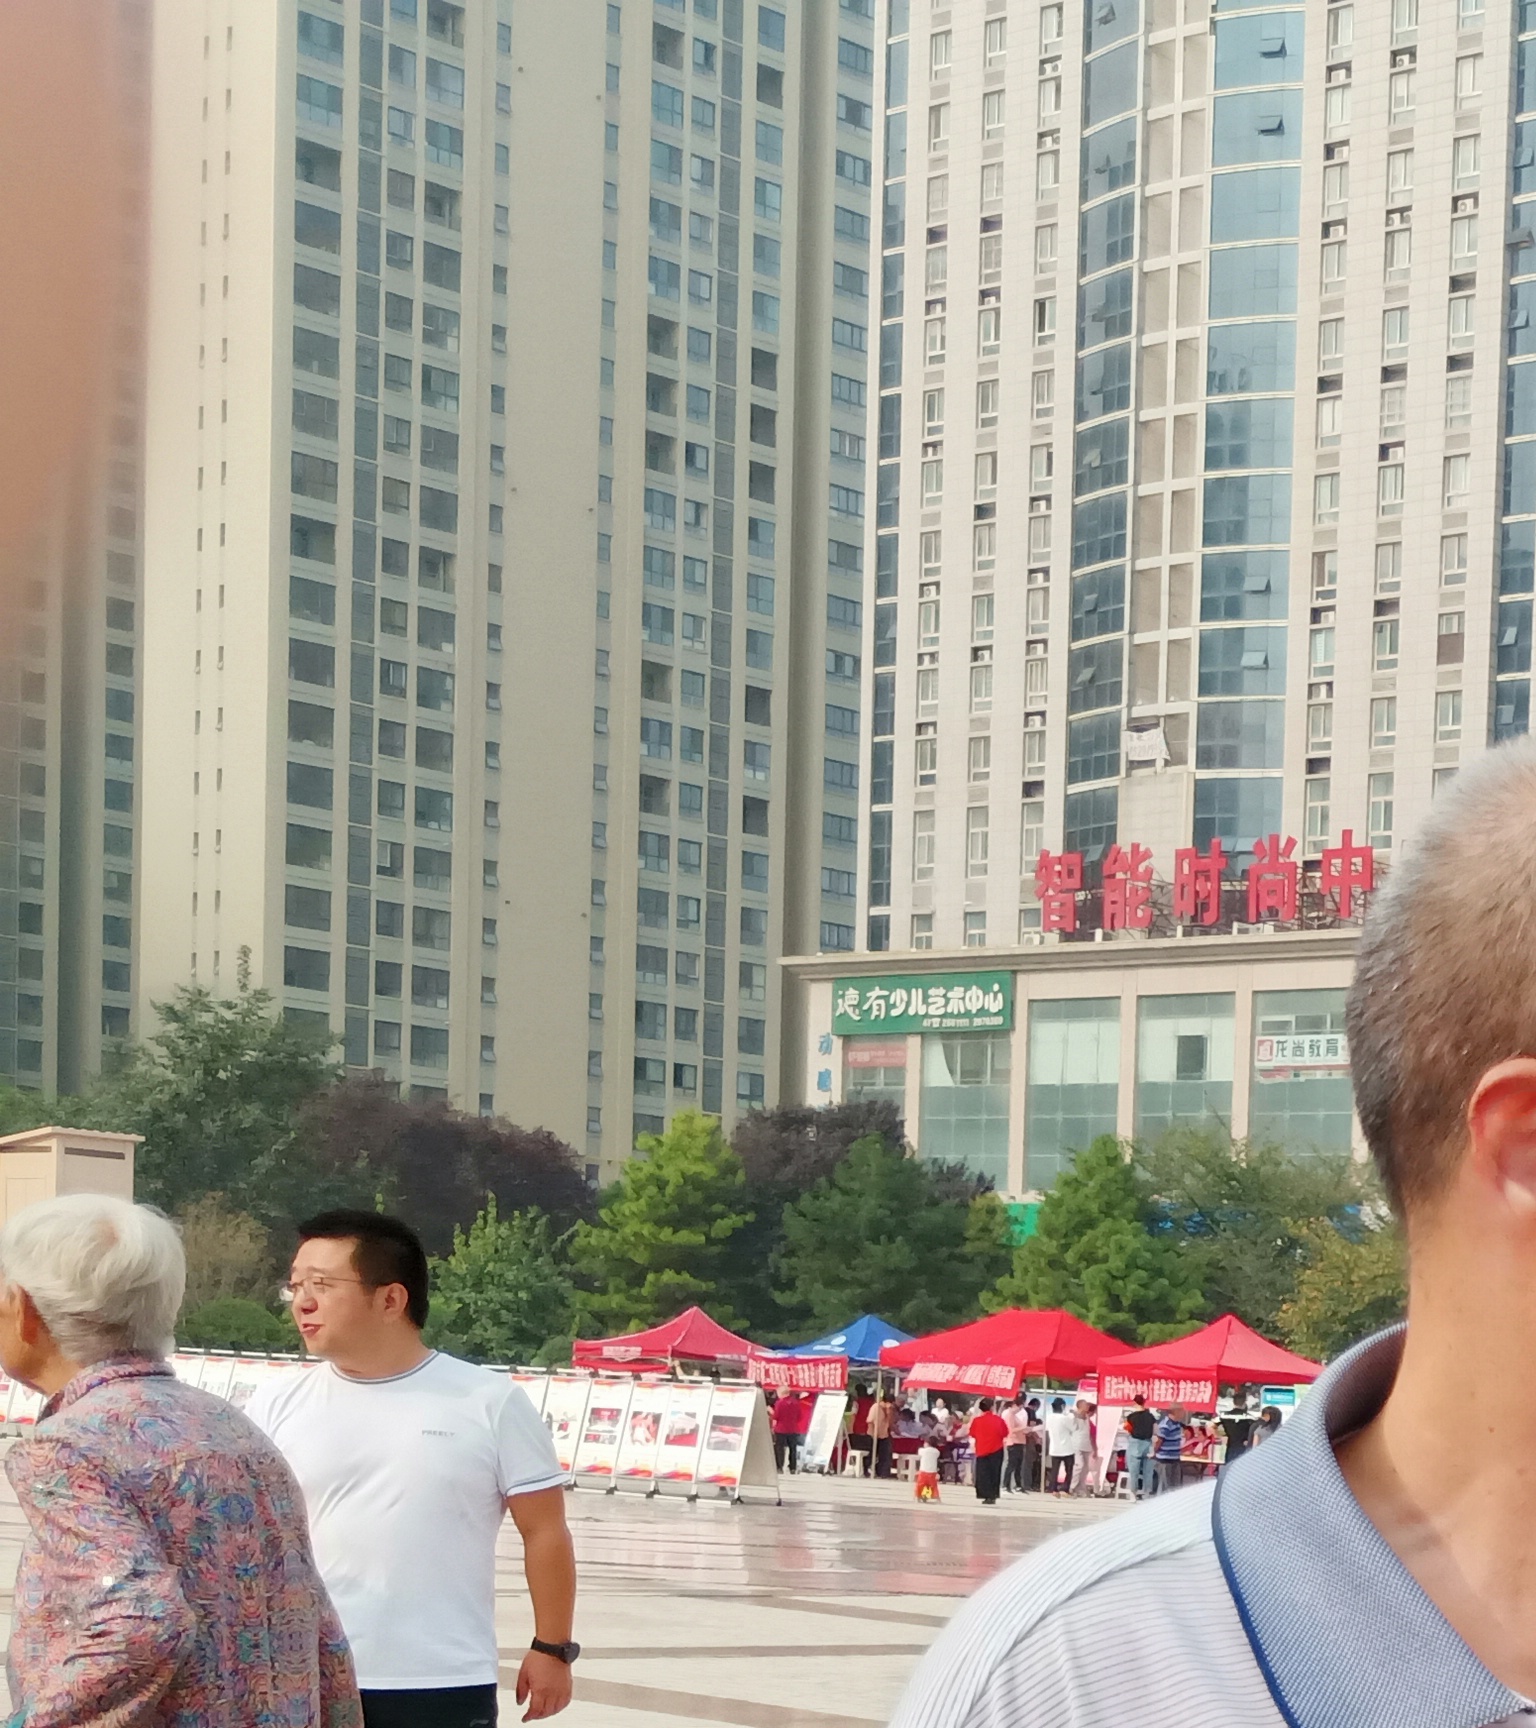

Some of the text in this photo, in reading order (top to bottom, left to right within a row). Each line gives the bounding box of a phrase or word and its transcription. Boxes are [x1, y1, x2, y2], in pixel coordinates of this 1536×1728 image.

[1035, 829, 1374, 932] 智能时尚中
